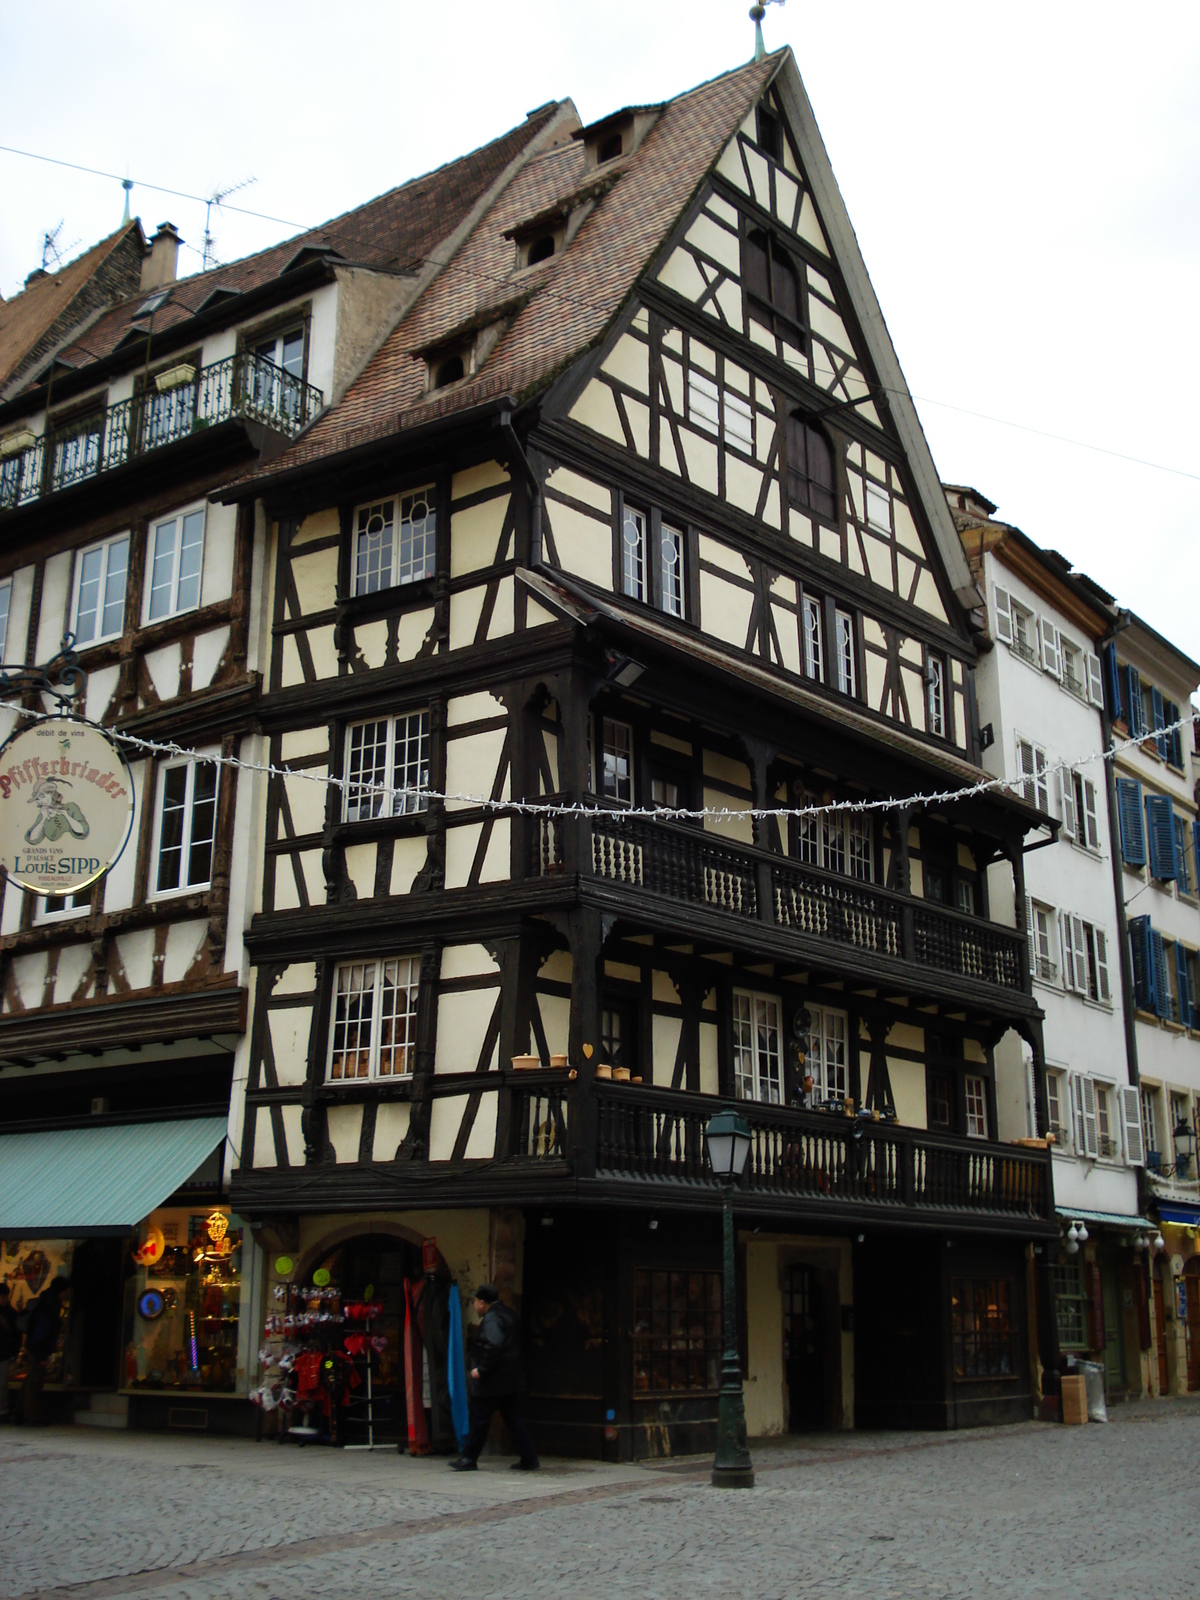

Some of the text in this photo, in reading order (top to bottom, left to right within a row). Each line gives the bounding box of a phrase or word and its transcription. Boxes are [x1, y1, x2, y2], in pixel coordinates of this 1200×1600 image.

[57, 729, 67, 737] de
[70, 729, 85, 737] vins
[22, 847, 47, 855] GRANDS
[13, 856, 100, 875] Louis SIPP
